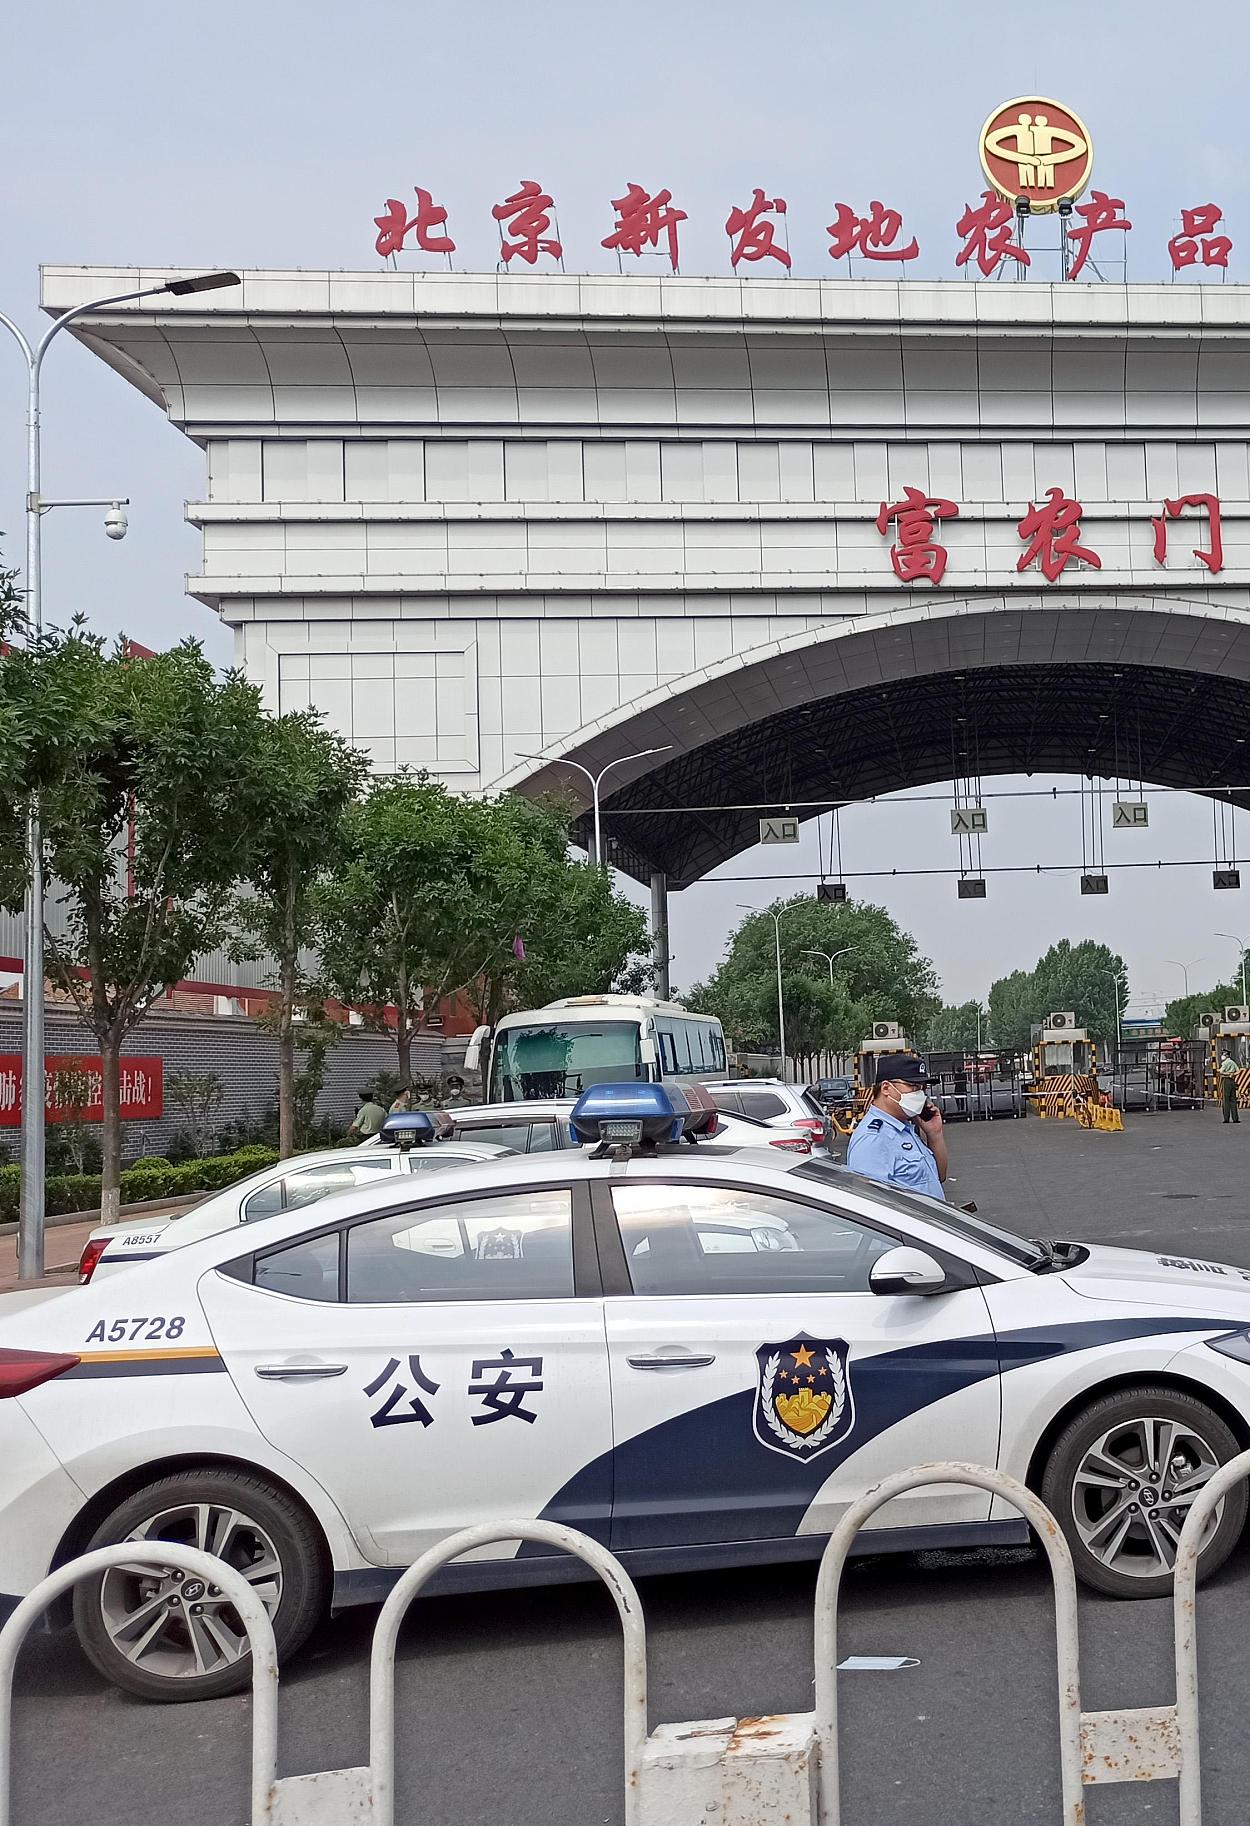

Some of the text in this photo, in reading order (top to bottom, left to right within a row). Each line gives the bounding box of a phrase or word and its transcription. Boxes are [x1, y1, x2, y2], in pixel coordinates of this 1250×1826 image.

[875, 486, 1223, 584] 富农门
[953, 813, 986, 830] 入口
[1115, 807, 1147, 824] 入口
[764, 822, 797, 840] 入口
[820, 887, 846, 900] 入口
[961, 883, 984, 895] 入口
[1084, 879, 1107, 891] 入口
[122, 1234, 161, 1246] A8557
[85, 1316, 186, 1343] A5728
[363, 1348, 544, 1428] 公安
